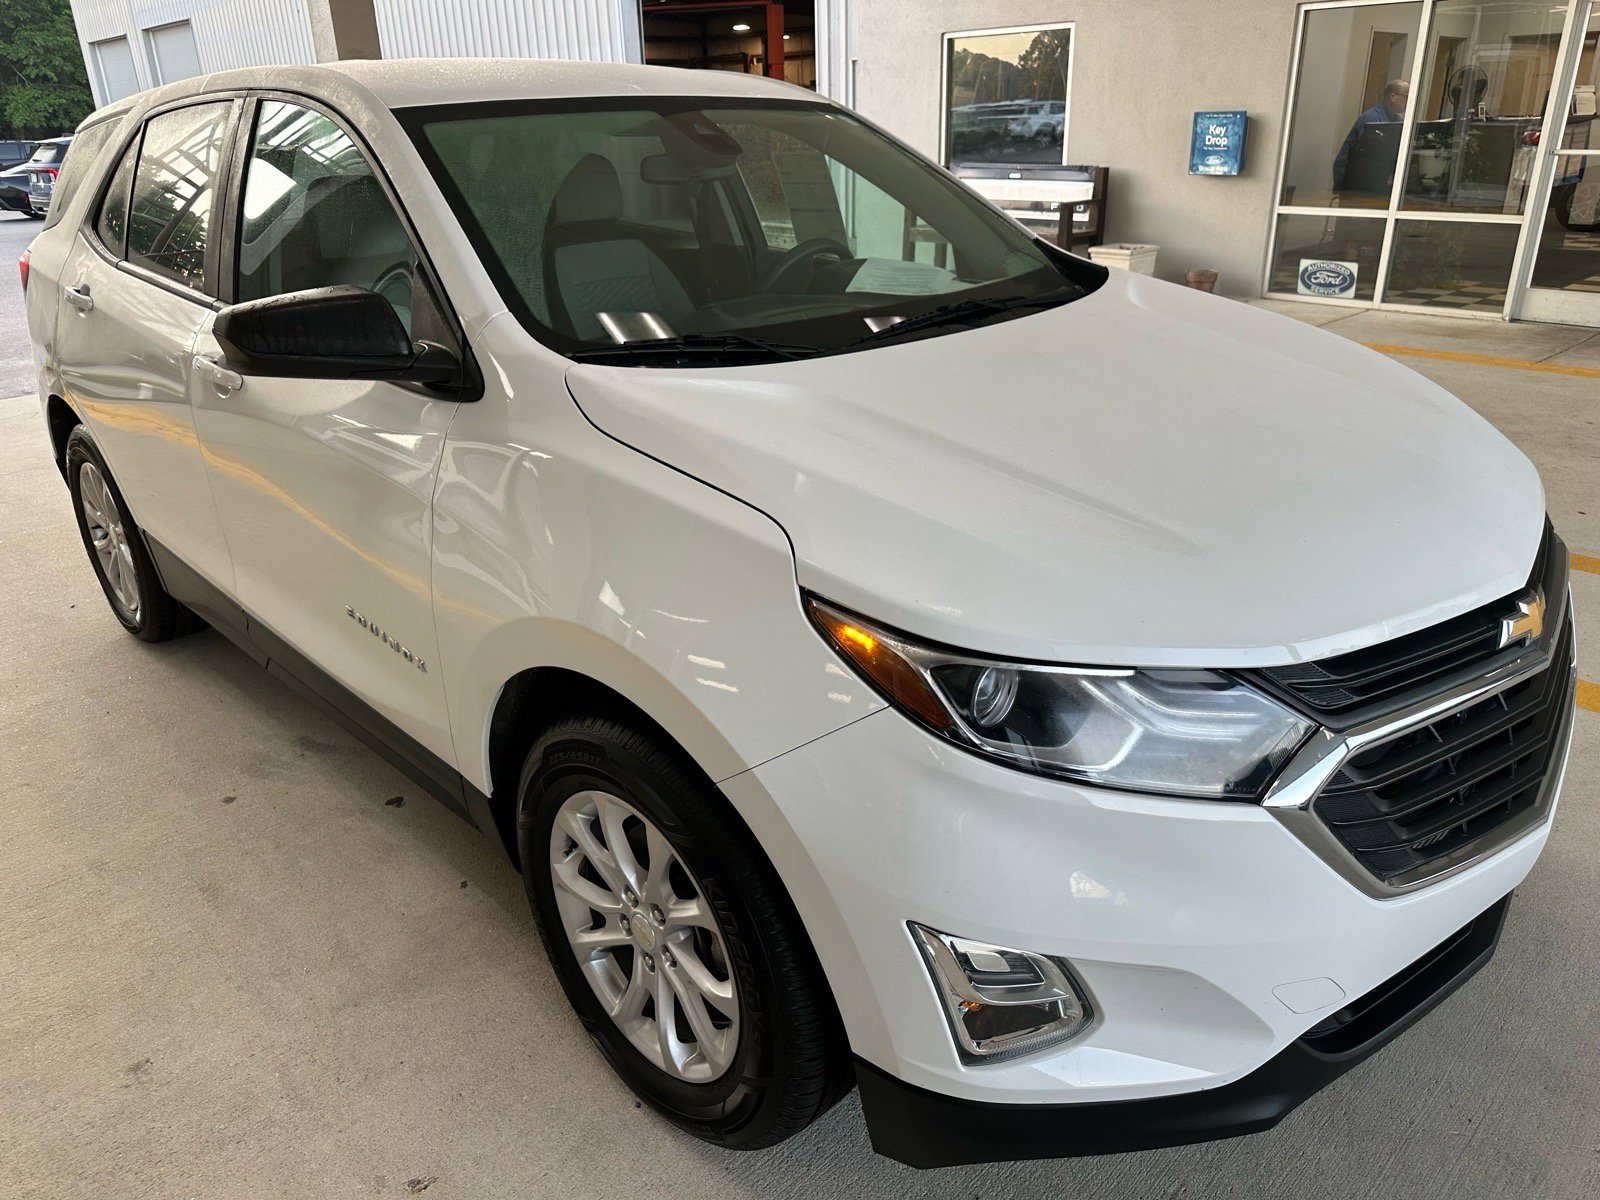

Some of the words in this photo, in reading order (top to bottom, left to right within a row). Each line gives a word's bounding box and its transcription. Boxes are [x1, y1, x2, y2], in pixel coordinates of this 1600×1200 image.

[1209, 124, 1226, 136] Key
[1205, 135, 1228, 147] Drop
[1308, 262, 1351, 275] AUTHORIZED
[1311, 271, 1344, 285] Ford
[1310, 287, 1341, 295] SERVICE
[345, 604, 427, 673] EQUINOX
